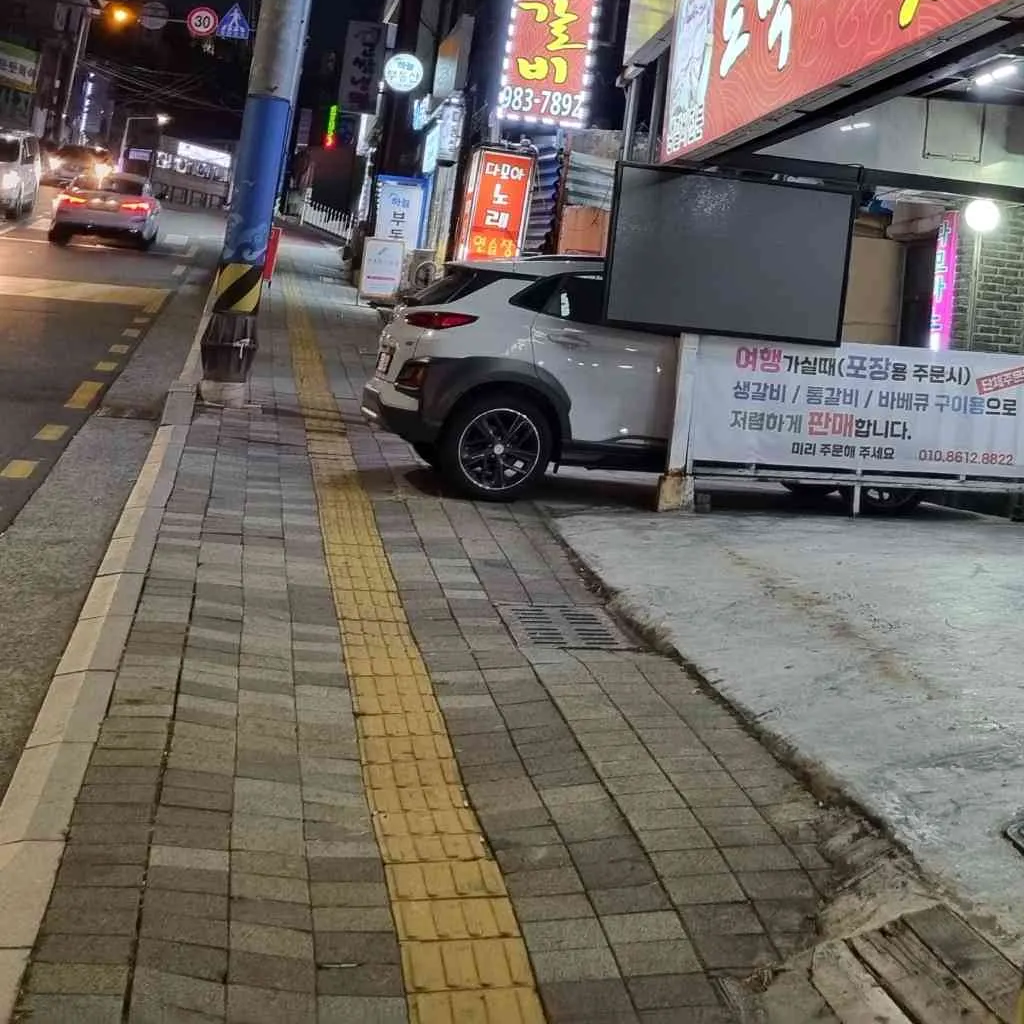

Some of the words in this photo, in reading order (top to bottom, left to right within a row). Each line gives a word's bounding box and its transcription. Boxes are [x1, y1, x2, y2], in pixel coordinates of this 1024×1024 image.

[195, 15, 210, 27] 30
[500, 86, 584, 118] 983-7892
[912, 363, 971, 386] 주문시)
[733, 380, 787, 403] 생갈비
[878, 390, 929, 412] 바베큐
[934, 394, 1017, 417] 구이용으로
[730, 410, 804, 434] 저렴하게
[807, 412, 912, 440] 판매합니다.
[791, 442, 817, 456] 미리
[820, 443, 855, 458] 주문해
[859, 446, 895, 460] 주세요
